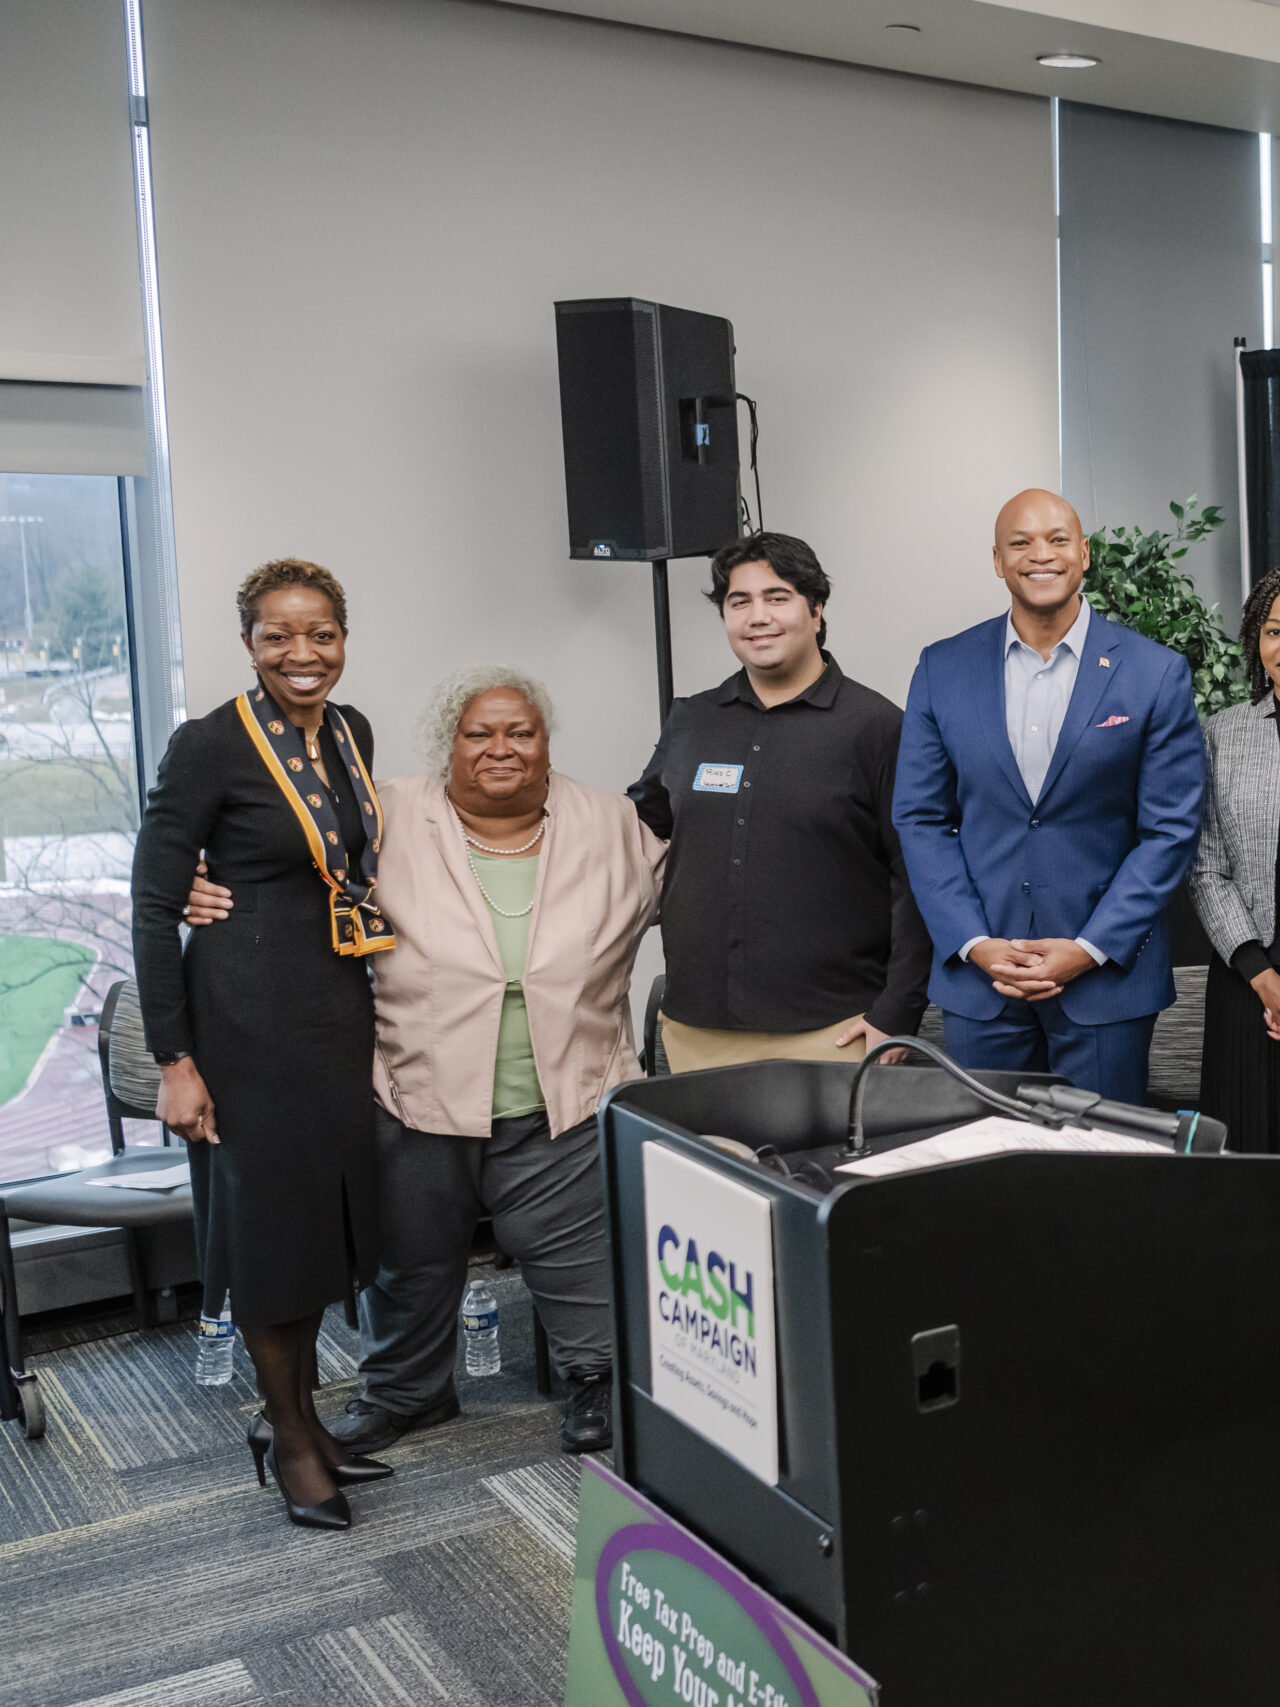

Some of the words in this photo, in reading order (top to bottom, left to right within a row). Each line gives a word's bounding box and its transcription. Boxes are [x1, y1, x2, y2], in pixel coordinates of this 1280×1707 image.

[658, 1225, 754, 1339] CASH
[659, 1291, 756, 1378] CAMPAIGN
[618, 1599, 665, 1682] Keep
[673, 1645, 719, 1707] Your
[620, 1562, 650, 1610] Free
[654, 1588, 678, 1635] Tax
[680, 1612, 714, 1669] Prep
[716, 1652, 746, 1694] and
